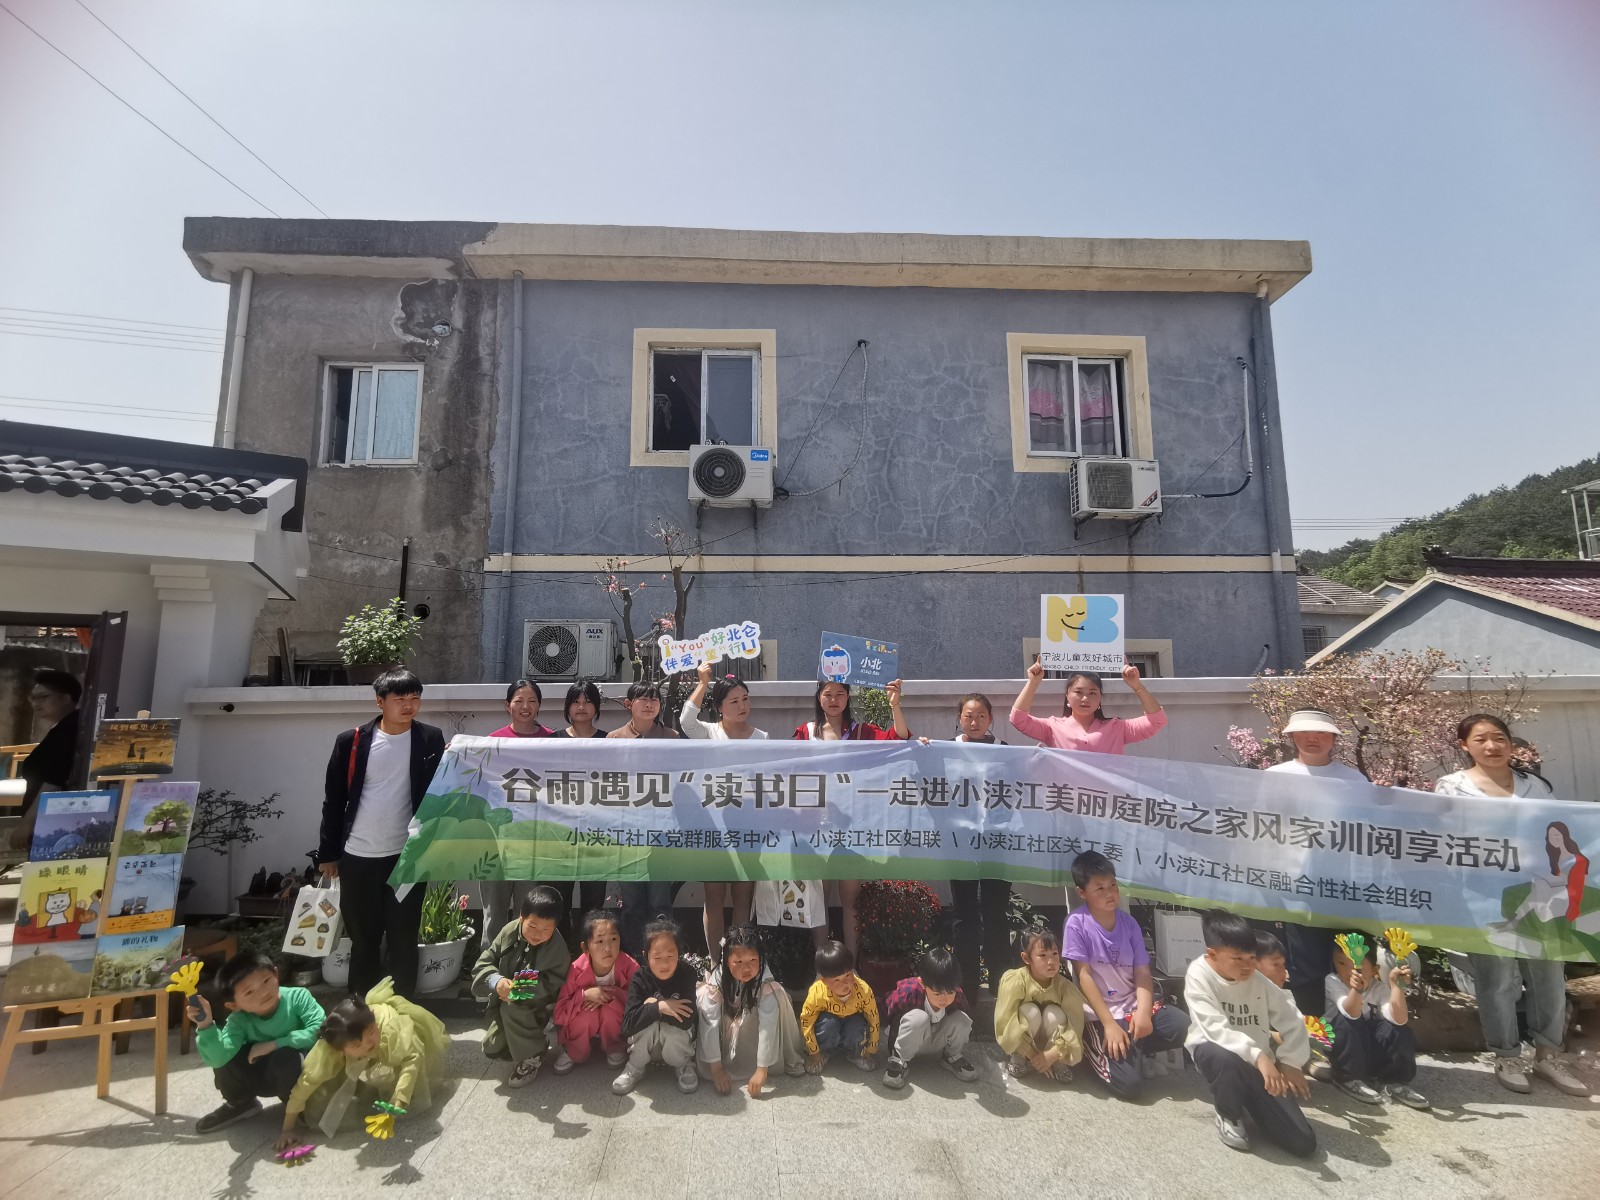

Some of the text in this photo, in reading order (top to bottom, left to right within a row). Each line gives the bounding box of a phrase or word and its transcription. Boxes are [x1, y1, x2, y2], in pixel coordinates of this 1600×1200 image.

[860, 657, 882, 670] 小北
[1042, 652, 1122, 663] 宁波儿童友好城市
[566, 827, 780, 848] 小浃江社区党群服务中心
[809, 829, 941, 849] 小浃江社区妇联
[1155, 852, 1433, 911] 小浃江社区融合性社会组织
